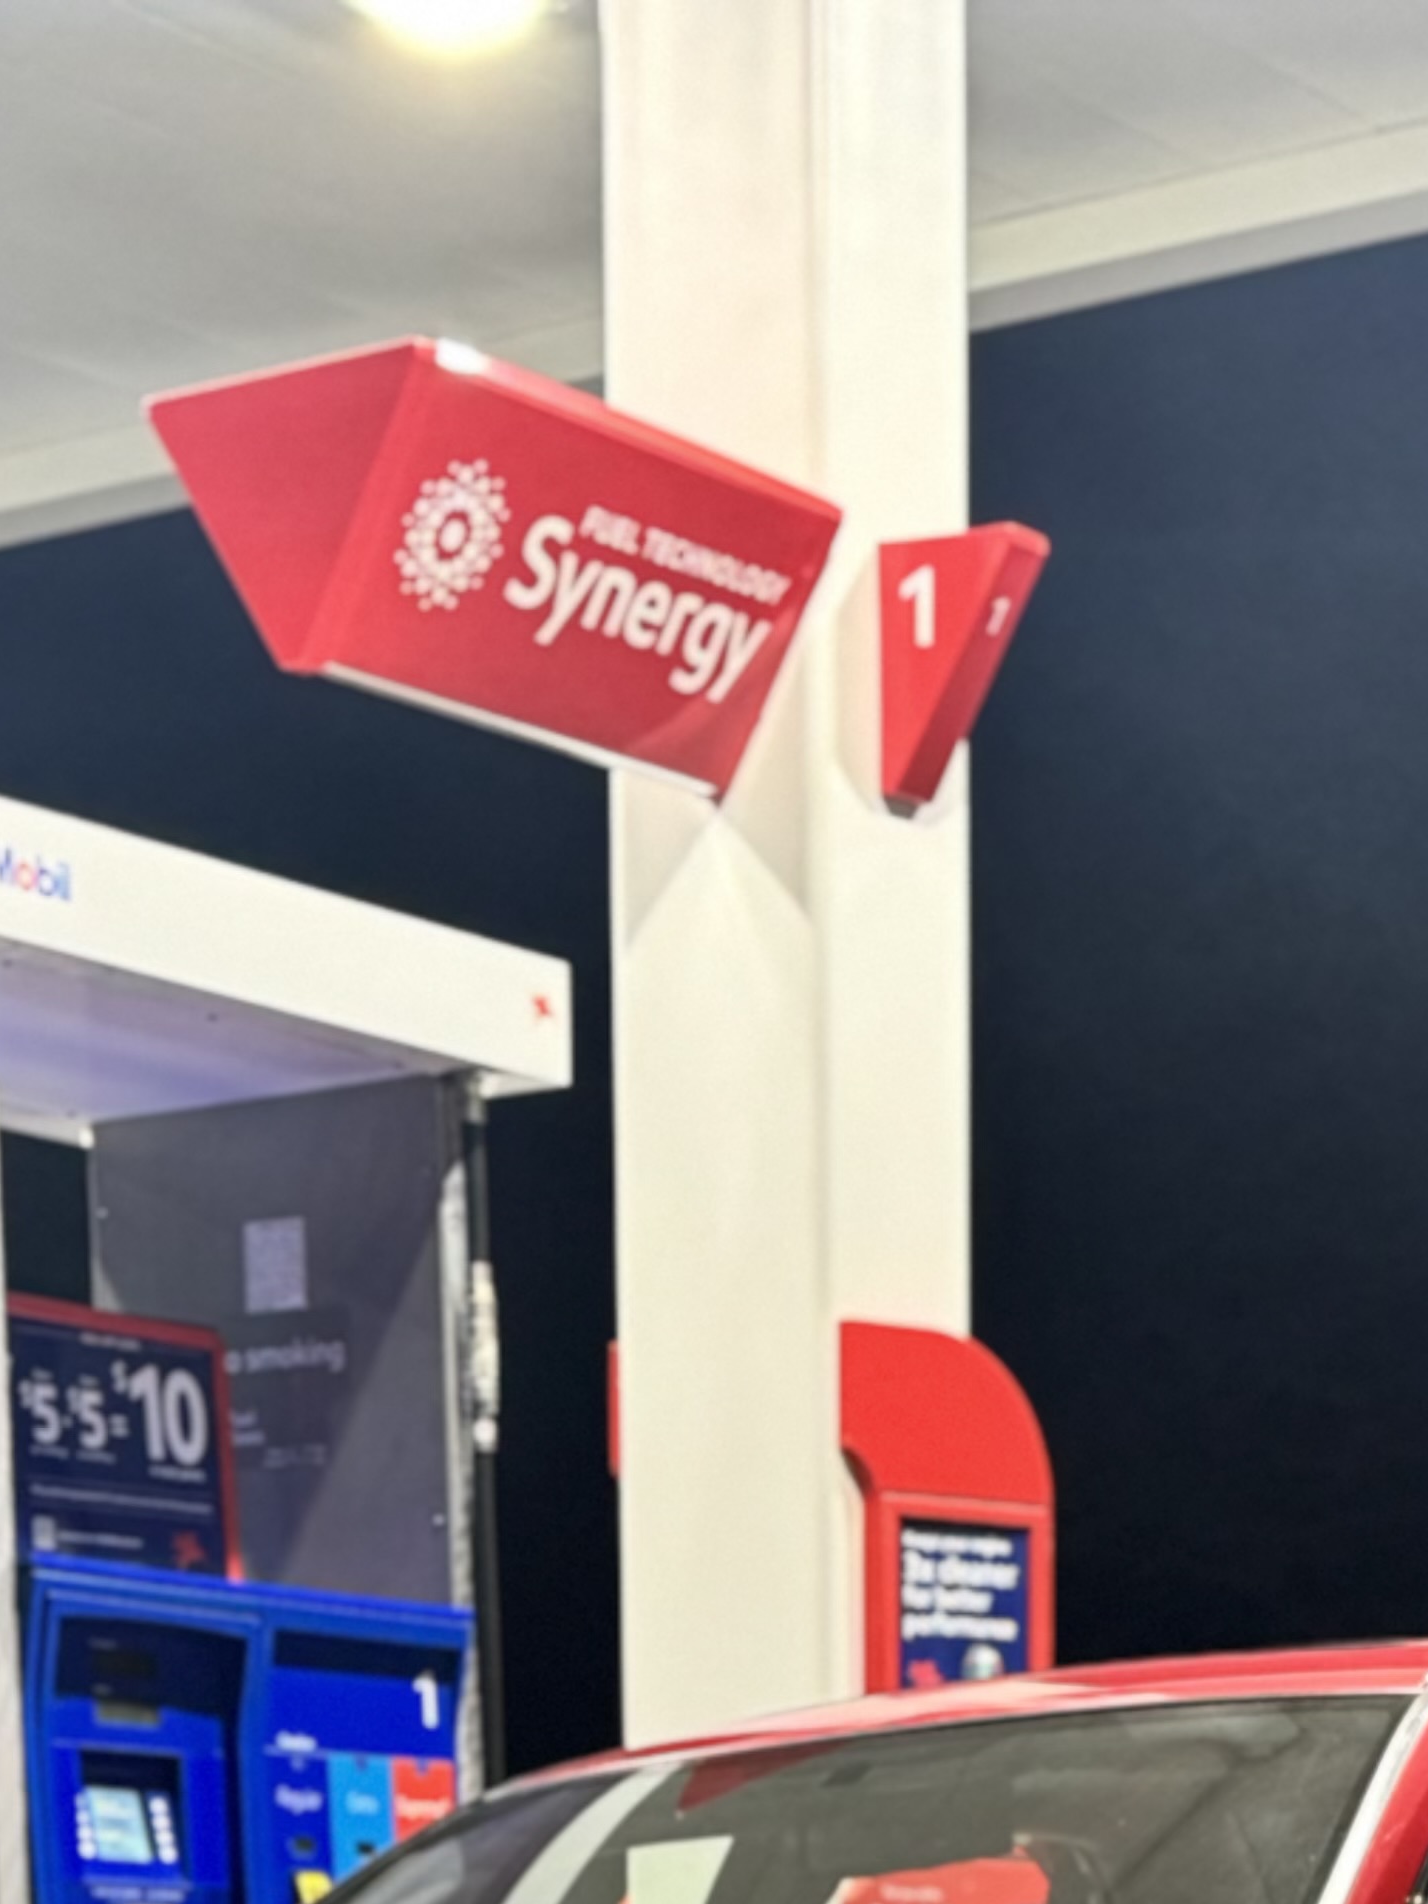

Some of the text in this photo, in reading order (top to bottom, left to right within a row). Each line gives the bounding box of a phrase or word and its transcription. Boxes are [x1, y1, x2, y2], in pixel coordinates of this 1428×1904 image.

[579, 505, 792, 606] FUEL TECHNOLOGY
[503, 514, 772, 704] Synergy
[898, 563, 936, 649] 1
[985, 596, 1012, 636] 1
[245, 1337, 346, 1373] smoking
[111, 1361, 208, 1466] $10
[412, 1672, 440, 1730] 1
